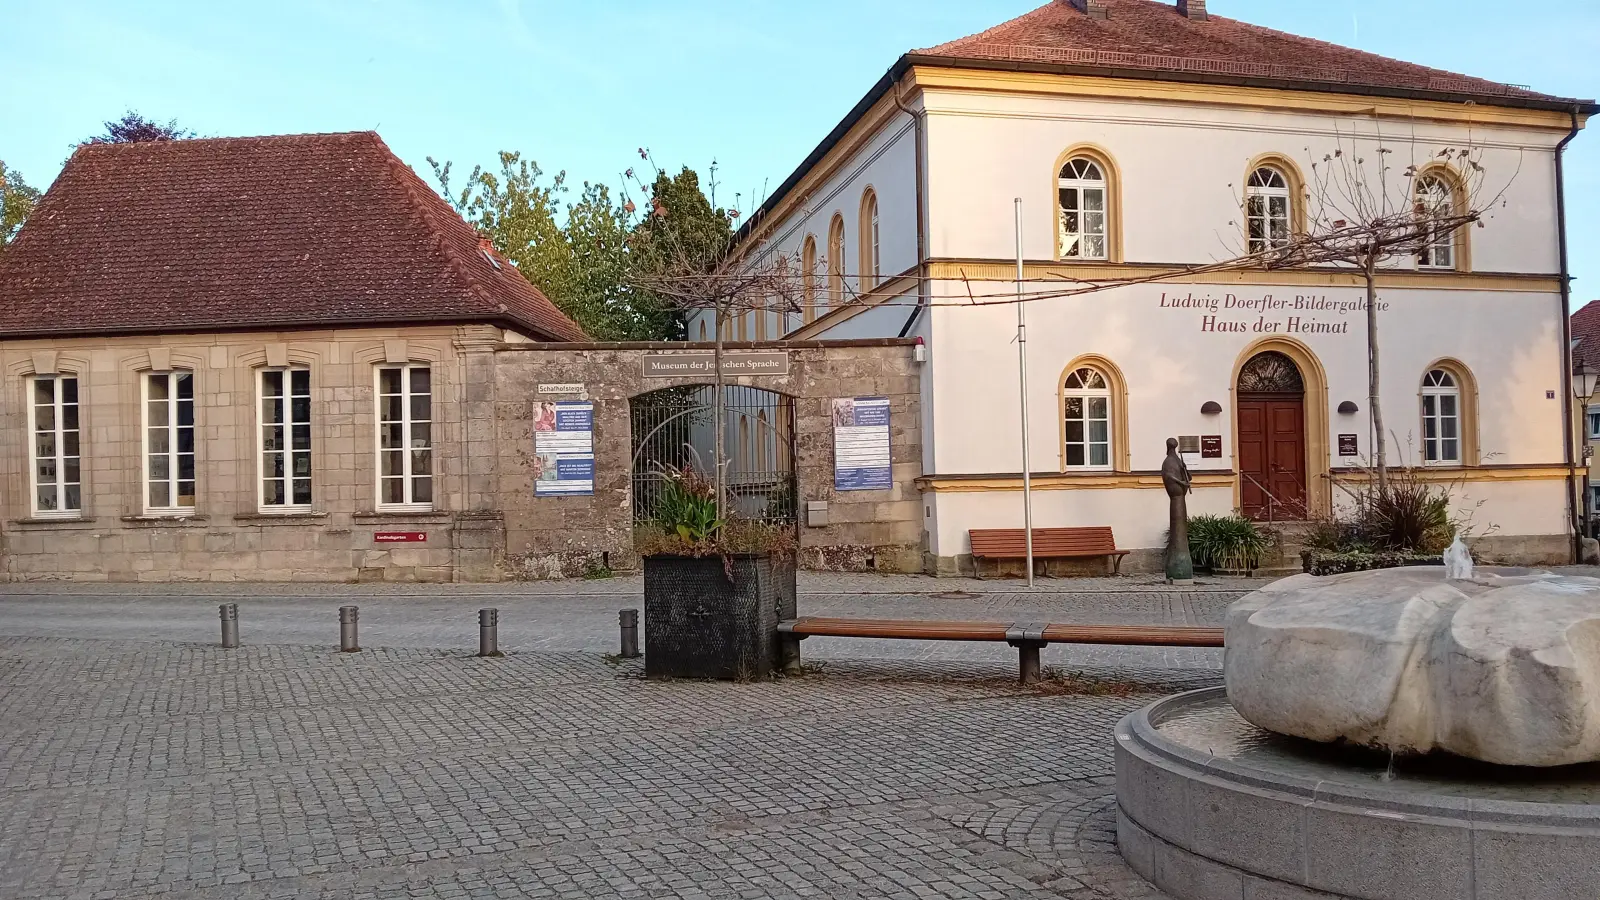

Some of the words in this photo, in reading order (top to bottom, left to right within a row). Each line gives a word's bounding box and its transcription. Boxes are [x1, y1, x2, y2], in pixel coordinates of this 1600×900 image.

[1159, 292, 1219, 312] Ludwig
[1224, 293, 1389, 315] Doerfler-Bildergaleie
[1201, 315, 1247, 333] Haus
[1252, 316, 1281, 333] der
[1286, 316, 1348, 334] Heimat
[651, 361, 688, 370] Museum
[690, 361, 703, 369] der
[704, 360, 745, 371] Jeschen
[747, 359, 780, 371] Sprache
